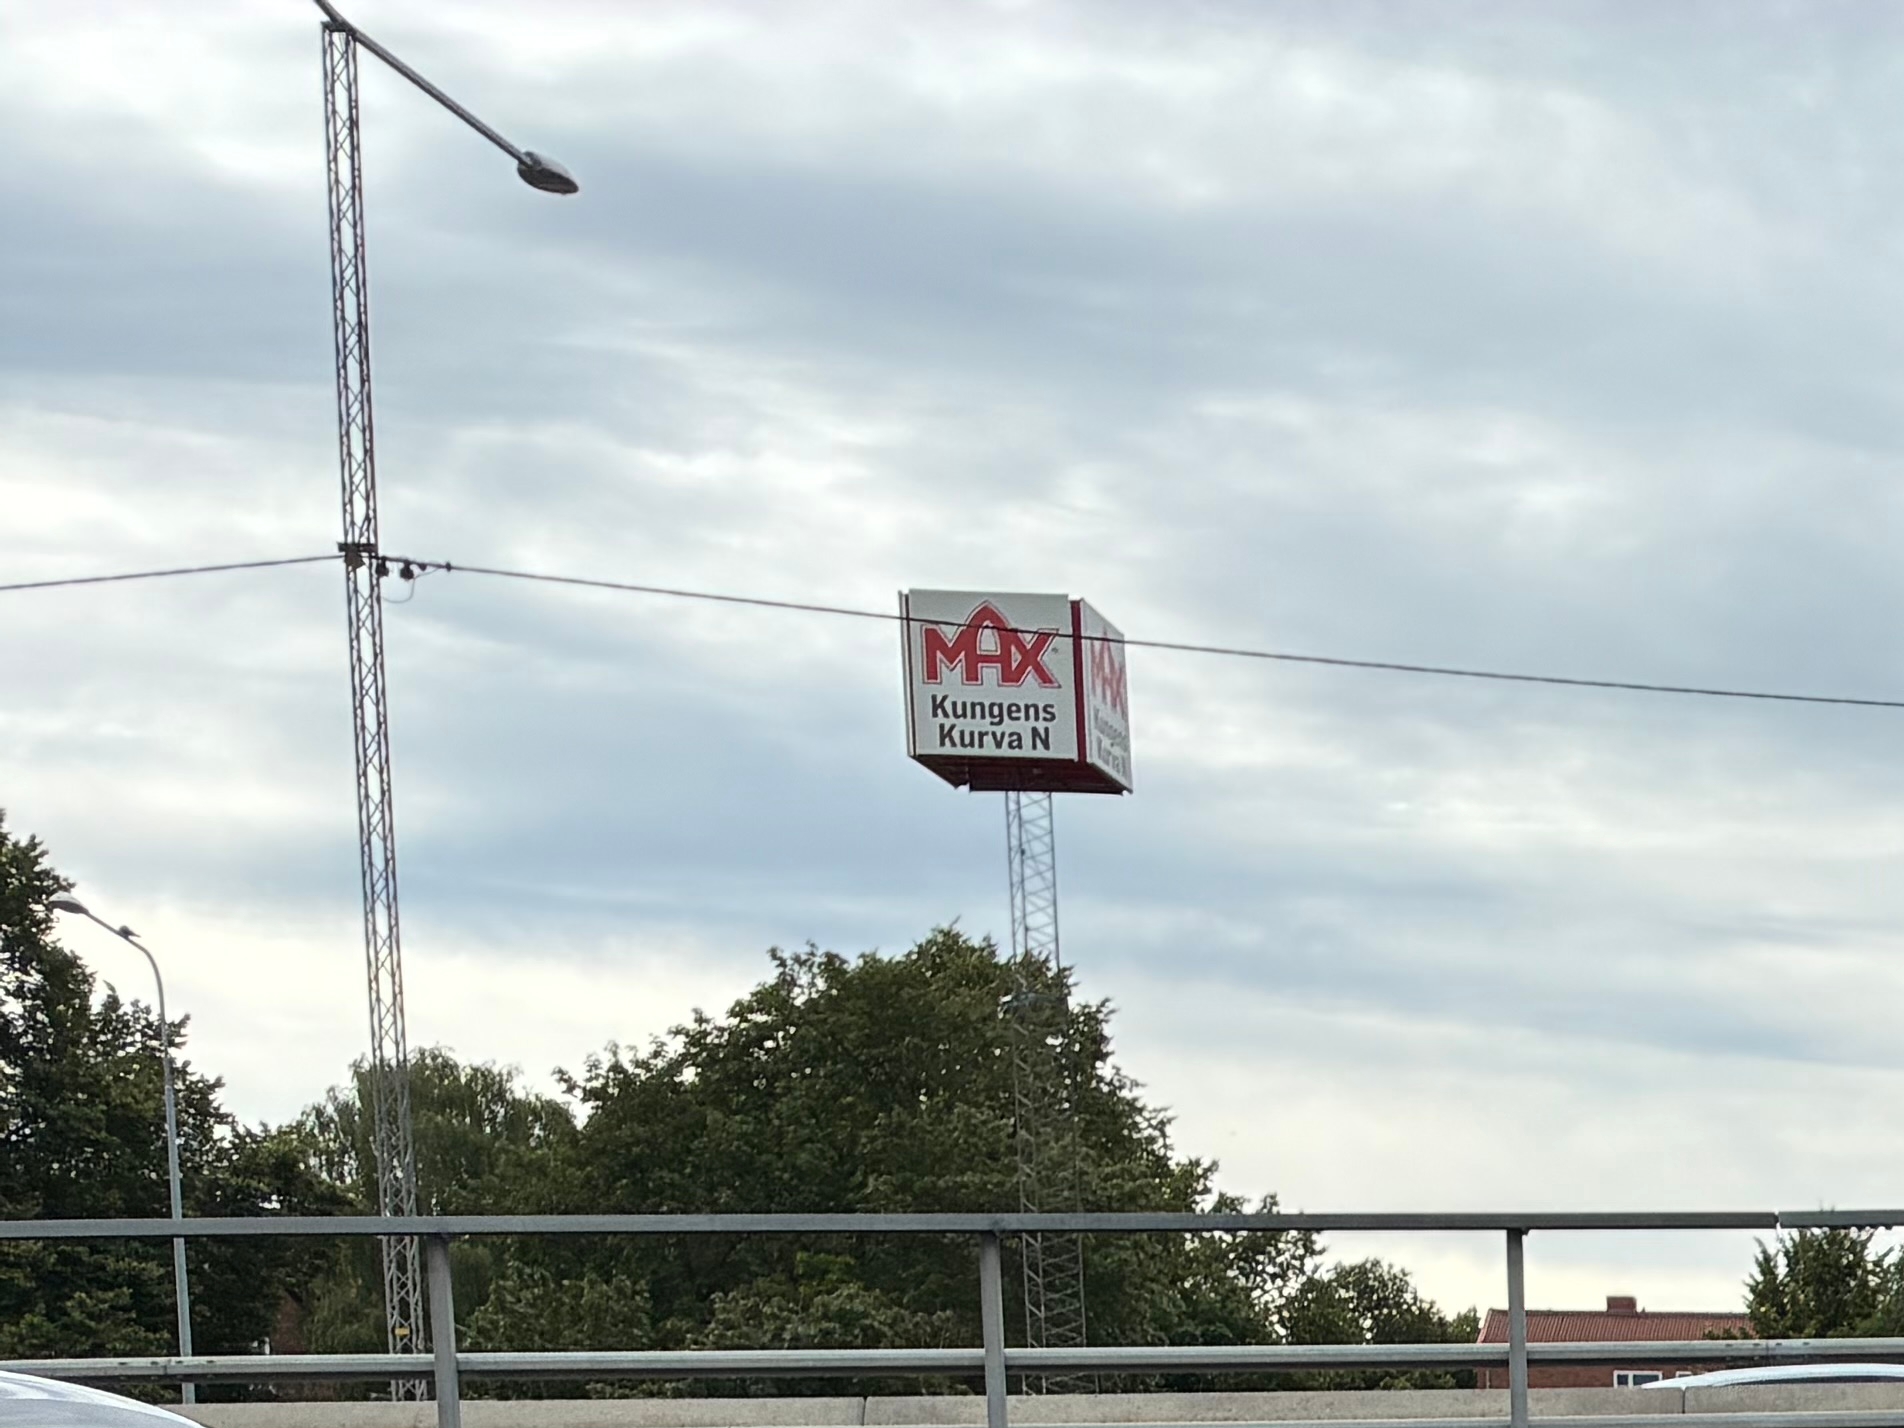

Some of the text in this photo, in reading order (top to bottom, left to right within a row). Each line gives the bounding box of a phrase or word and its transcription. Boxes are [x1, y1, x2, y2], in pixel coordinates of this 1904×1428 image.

[922, 601, 1062, 688] MAX
[931, 694, 1057, 726] Kungens
[939, 723, 1051, 751] Kurva N
